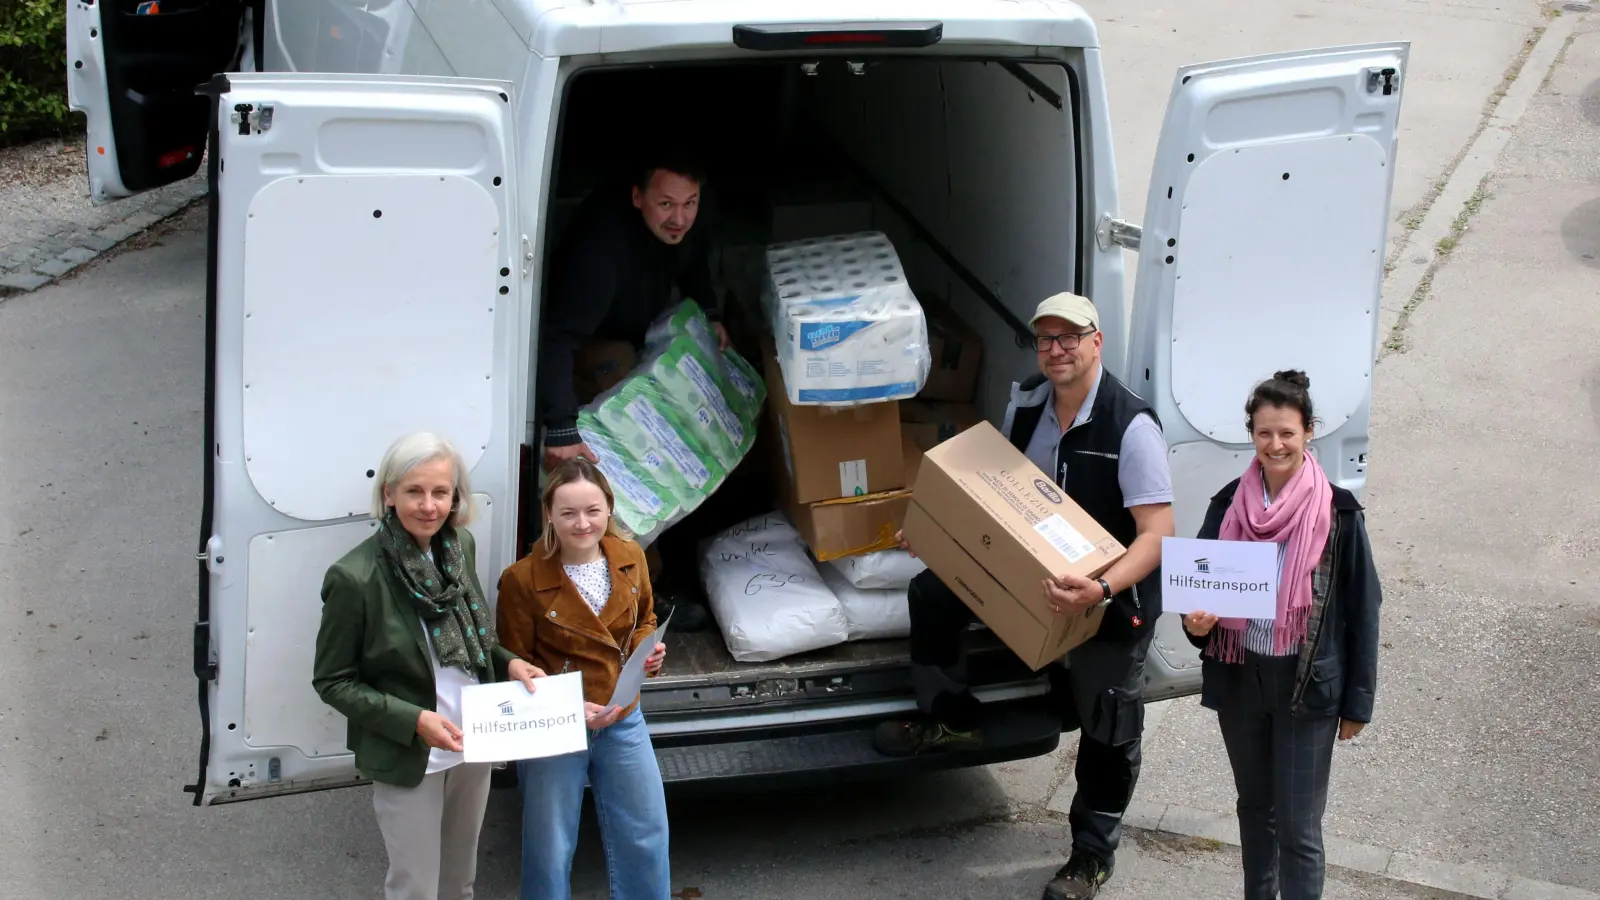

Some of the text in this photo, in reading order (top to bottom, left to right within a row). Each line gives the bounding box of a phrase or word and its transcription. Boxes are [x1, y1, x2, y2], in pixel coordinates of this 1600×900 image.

[1036, 481, 1061, 502] Barilla
[744, 573, 805, 596] 630
[1169, 574, 1269, 593] Hilfstransport
[472, 712, 577, 734] Hilfstransport
